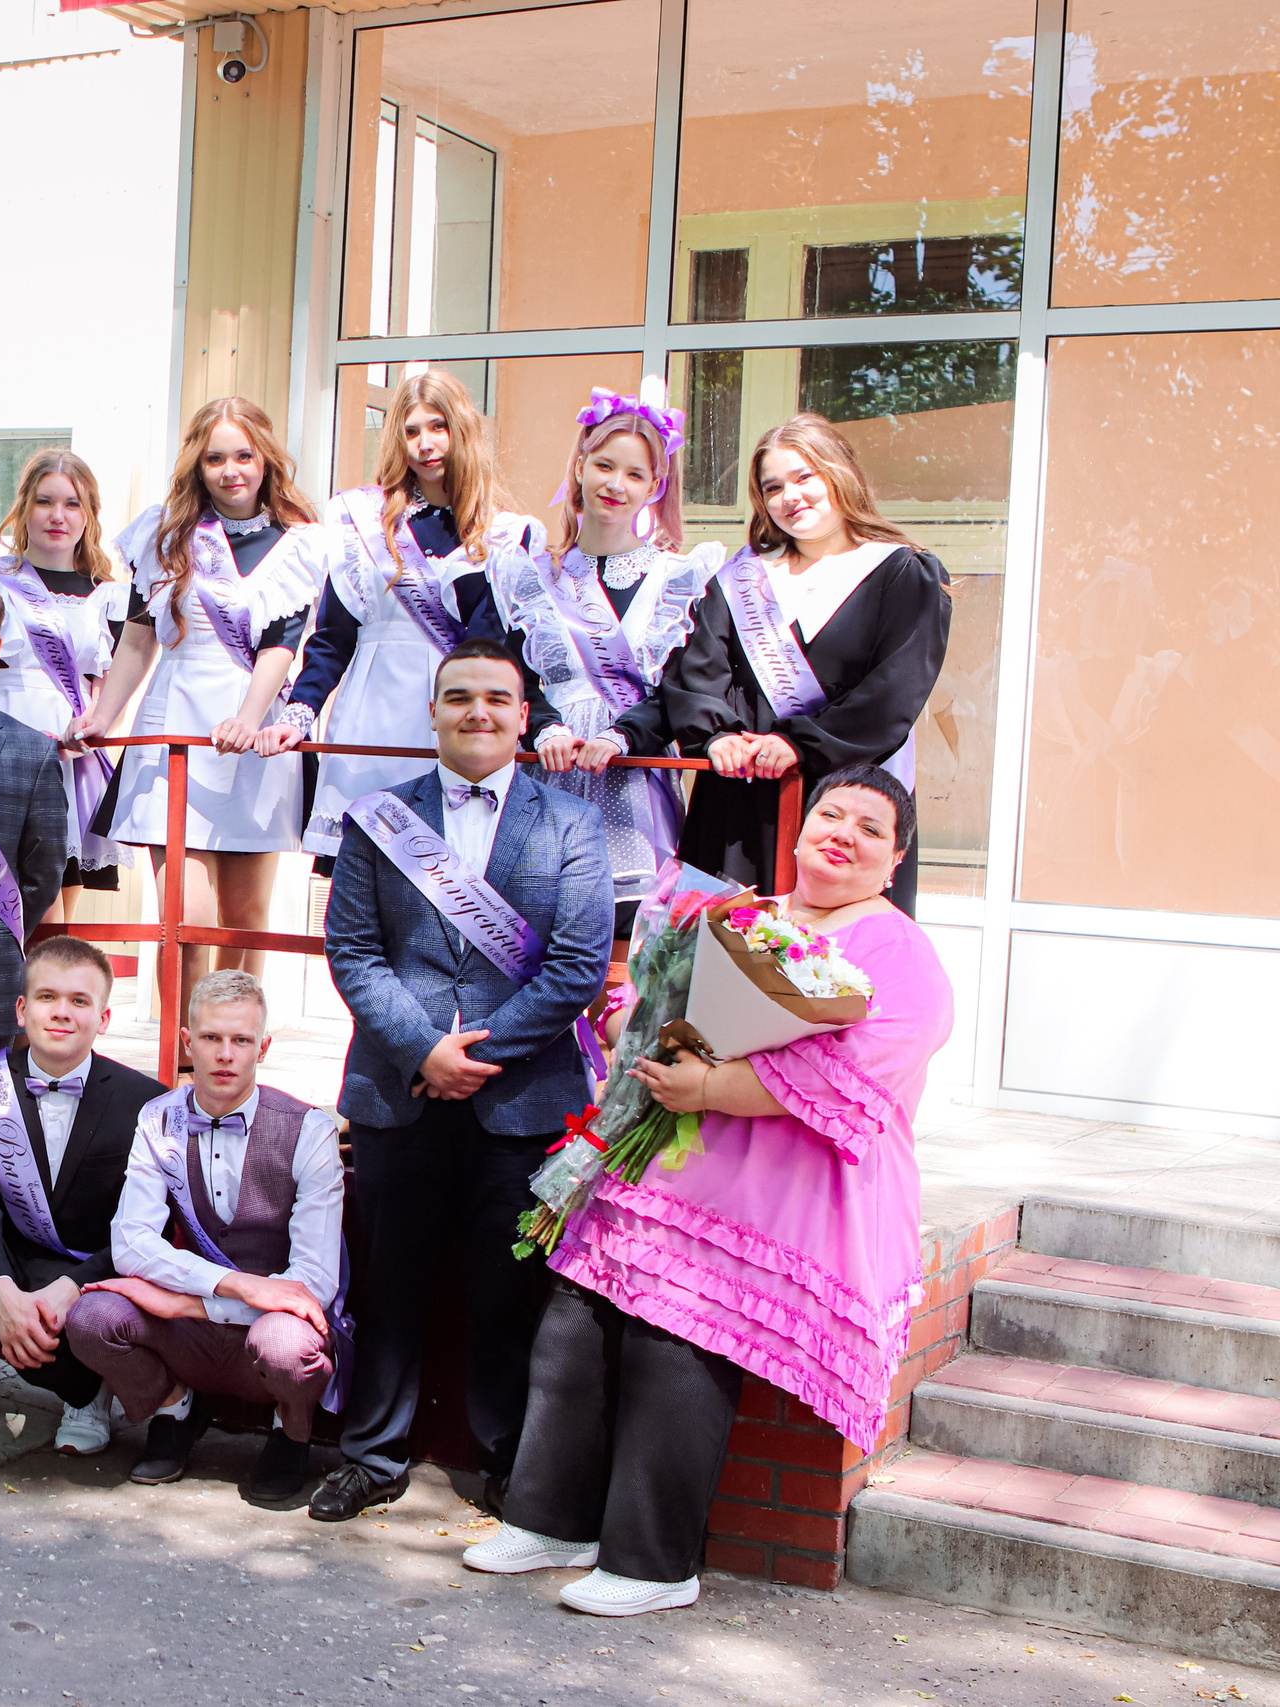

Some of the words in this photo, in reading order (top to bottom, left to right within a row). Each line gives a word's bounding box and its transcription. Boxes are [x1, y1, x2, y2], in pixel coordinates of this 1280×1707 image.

[411, 558, 435, 596] Петрова
[731, 562, 805, 710] Выпускница
[781, 642, 801, 676] Дарья
[402, 835, 532, 970] Выпускник
[464, 874, 504, 913] Ханнанов
[27, 1181, 46, 1213] Елисеев
